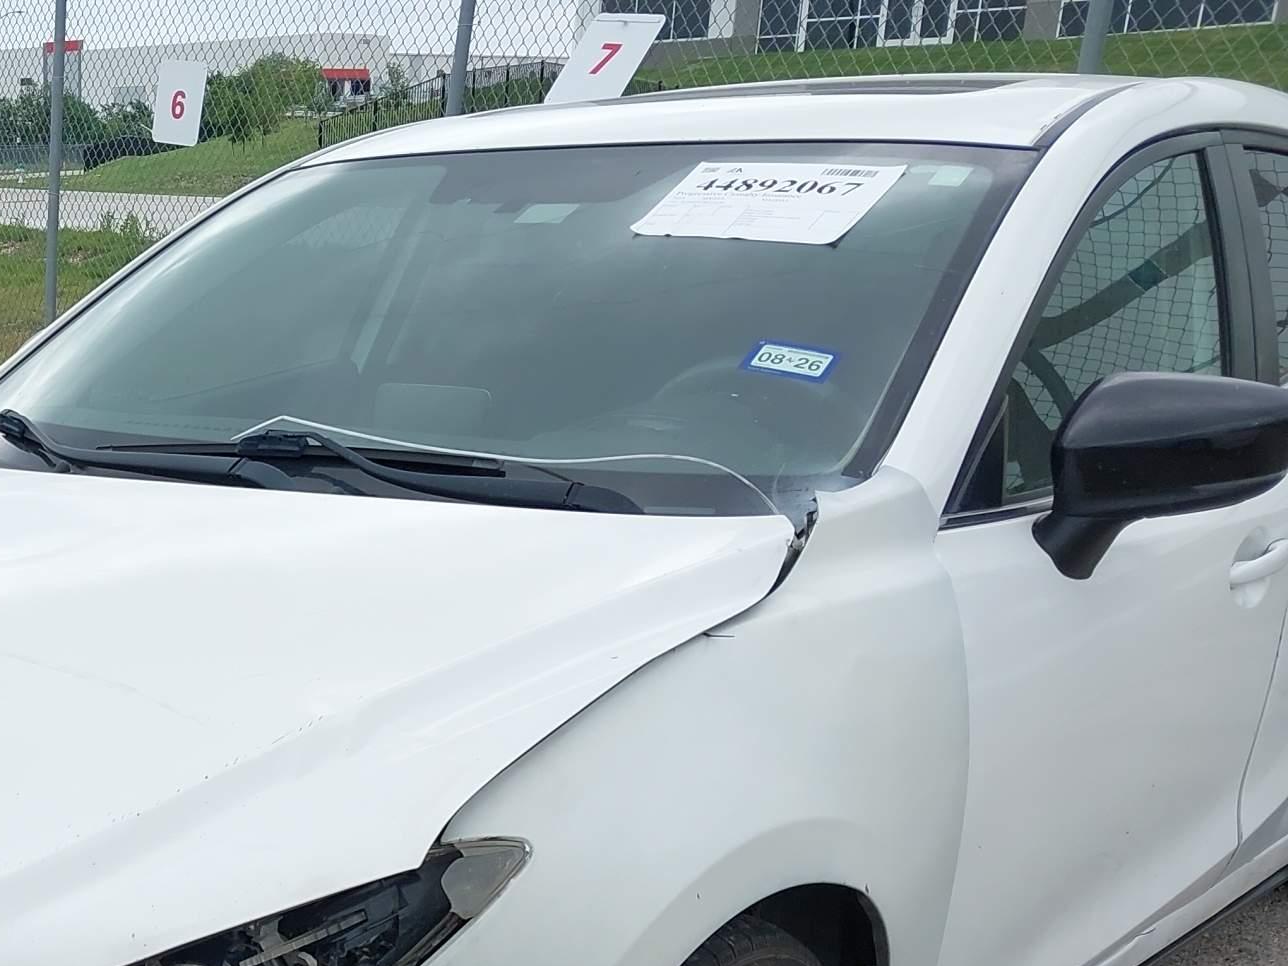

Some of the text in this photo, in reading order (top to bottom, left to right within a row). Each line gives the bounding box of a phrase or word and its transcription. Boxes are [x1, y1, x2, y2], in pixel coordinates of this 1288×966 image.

[589, 43, 623, 74] 7
[172, 90, 186, 119] 6
[696, 178, 864, 196] 44892067
